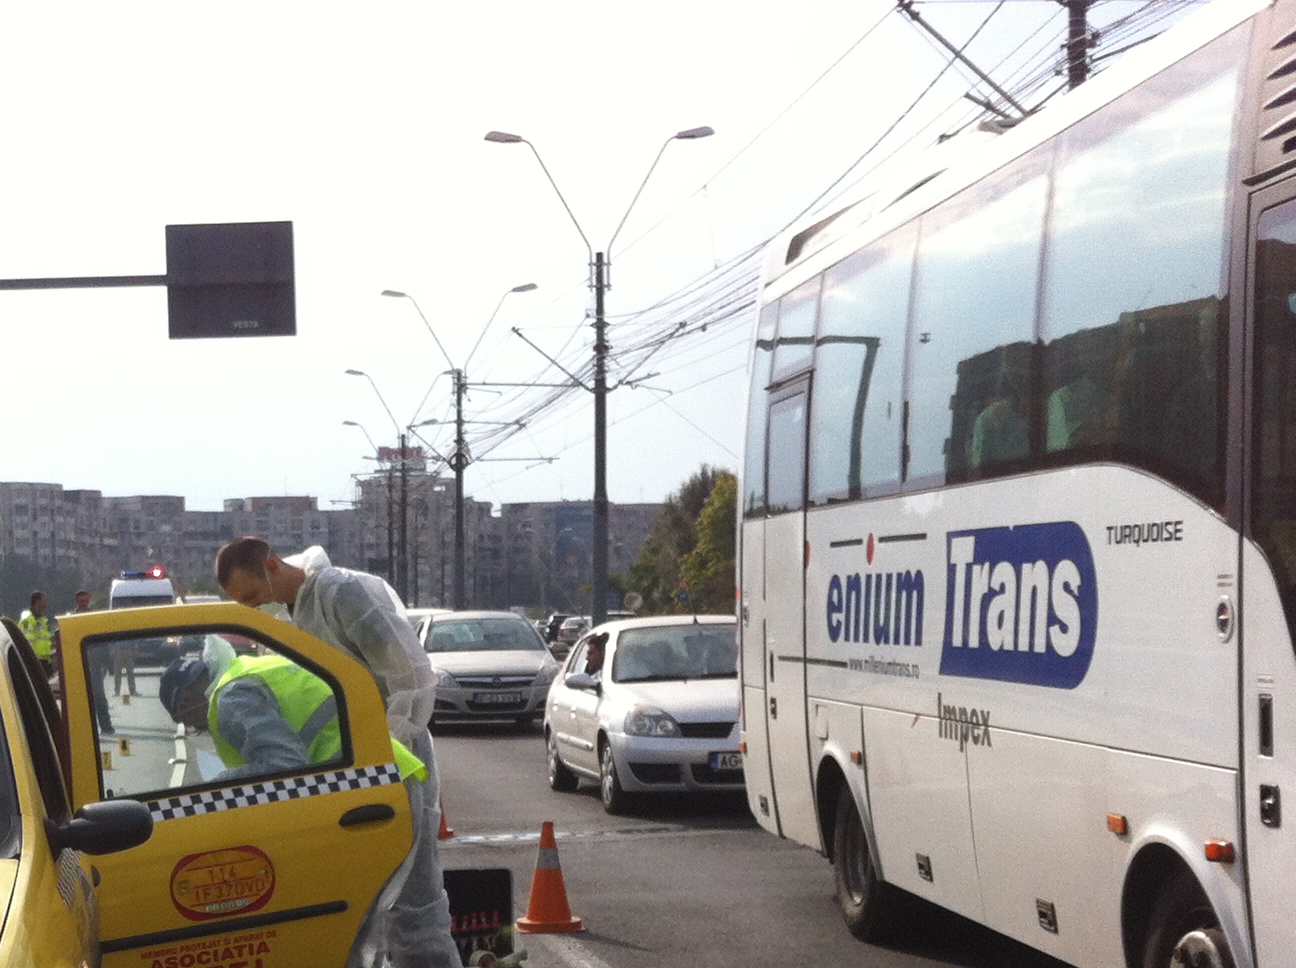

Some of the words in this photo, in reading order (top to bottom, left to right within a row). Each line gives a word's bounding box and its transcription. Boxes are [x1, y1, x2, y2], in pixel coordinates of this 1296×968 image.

[1106, 520, 1184, 547] TURQUOISE
[949, 535, 1082, 658] Trans
[937, 692, 992, 753] Impex
